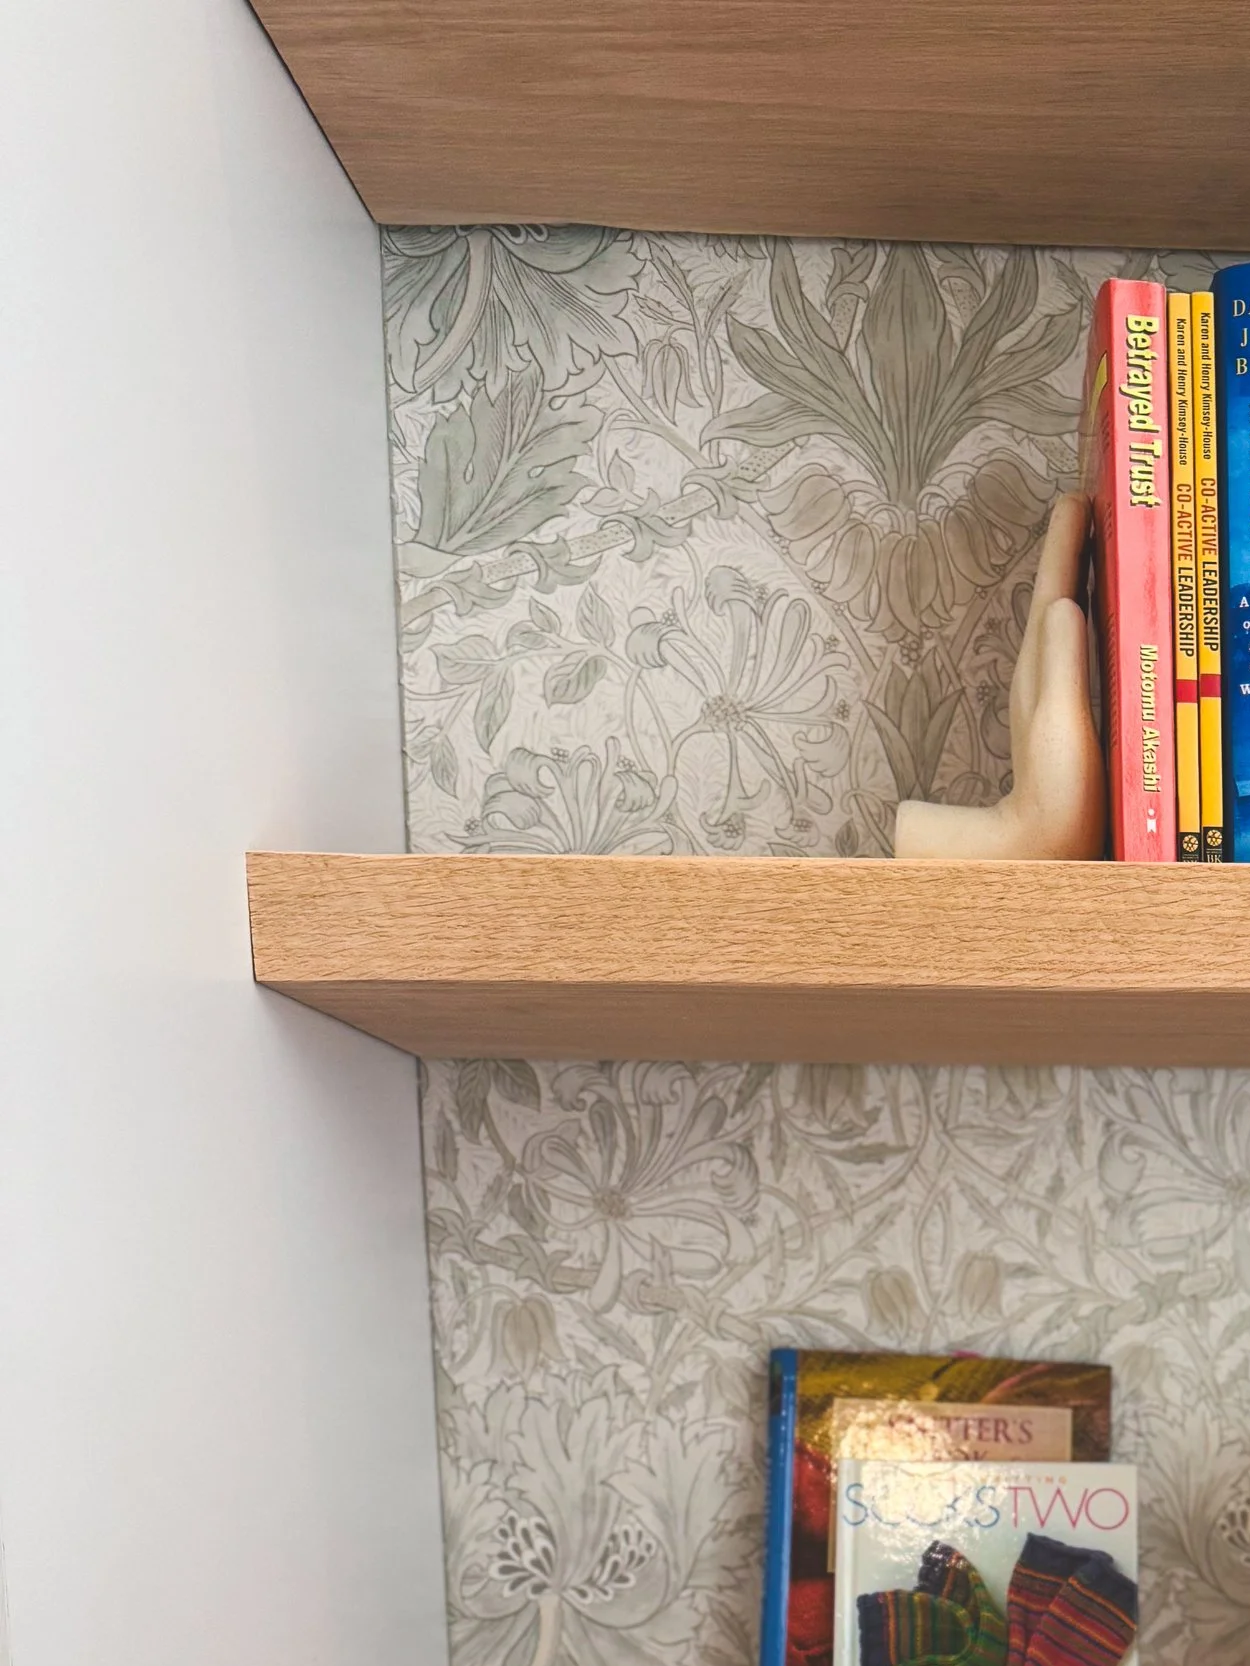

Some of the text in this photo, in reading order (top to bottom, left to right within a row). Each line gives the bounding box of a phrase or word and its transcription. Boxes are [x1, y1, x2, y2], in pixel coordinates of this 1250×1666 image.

[1119, 314, 1163, 508] Betrayed Trust
[1176, 318, 1189, 466] Karen and Henry Kimsey-House
[1200, 312, 1213, 460] Karen and Henry Kimsey-House
[1176, 483, 1195, 658] CO-ACTIVE LEADERSHIP
[1200, 477, 1219, 652] CO-ACTIVE LEADERSHIP
[1240, 596, 1249, 608] A
[1139, 644, 1161, 793] Motomu Akashi
[1005, 1486, 1130, 1531] TWO
